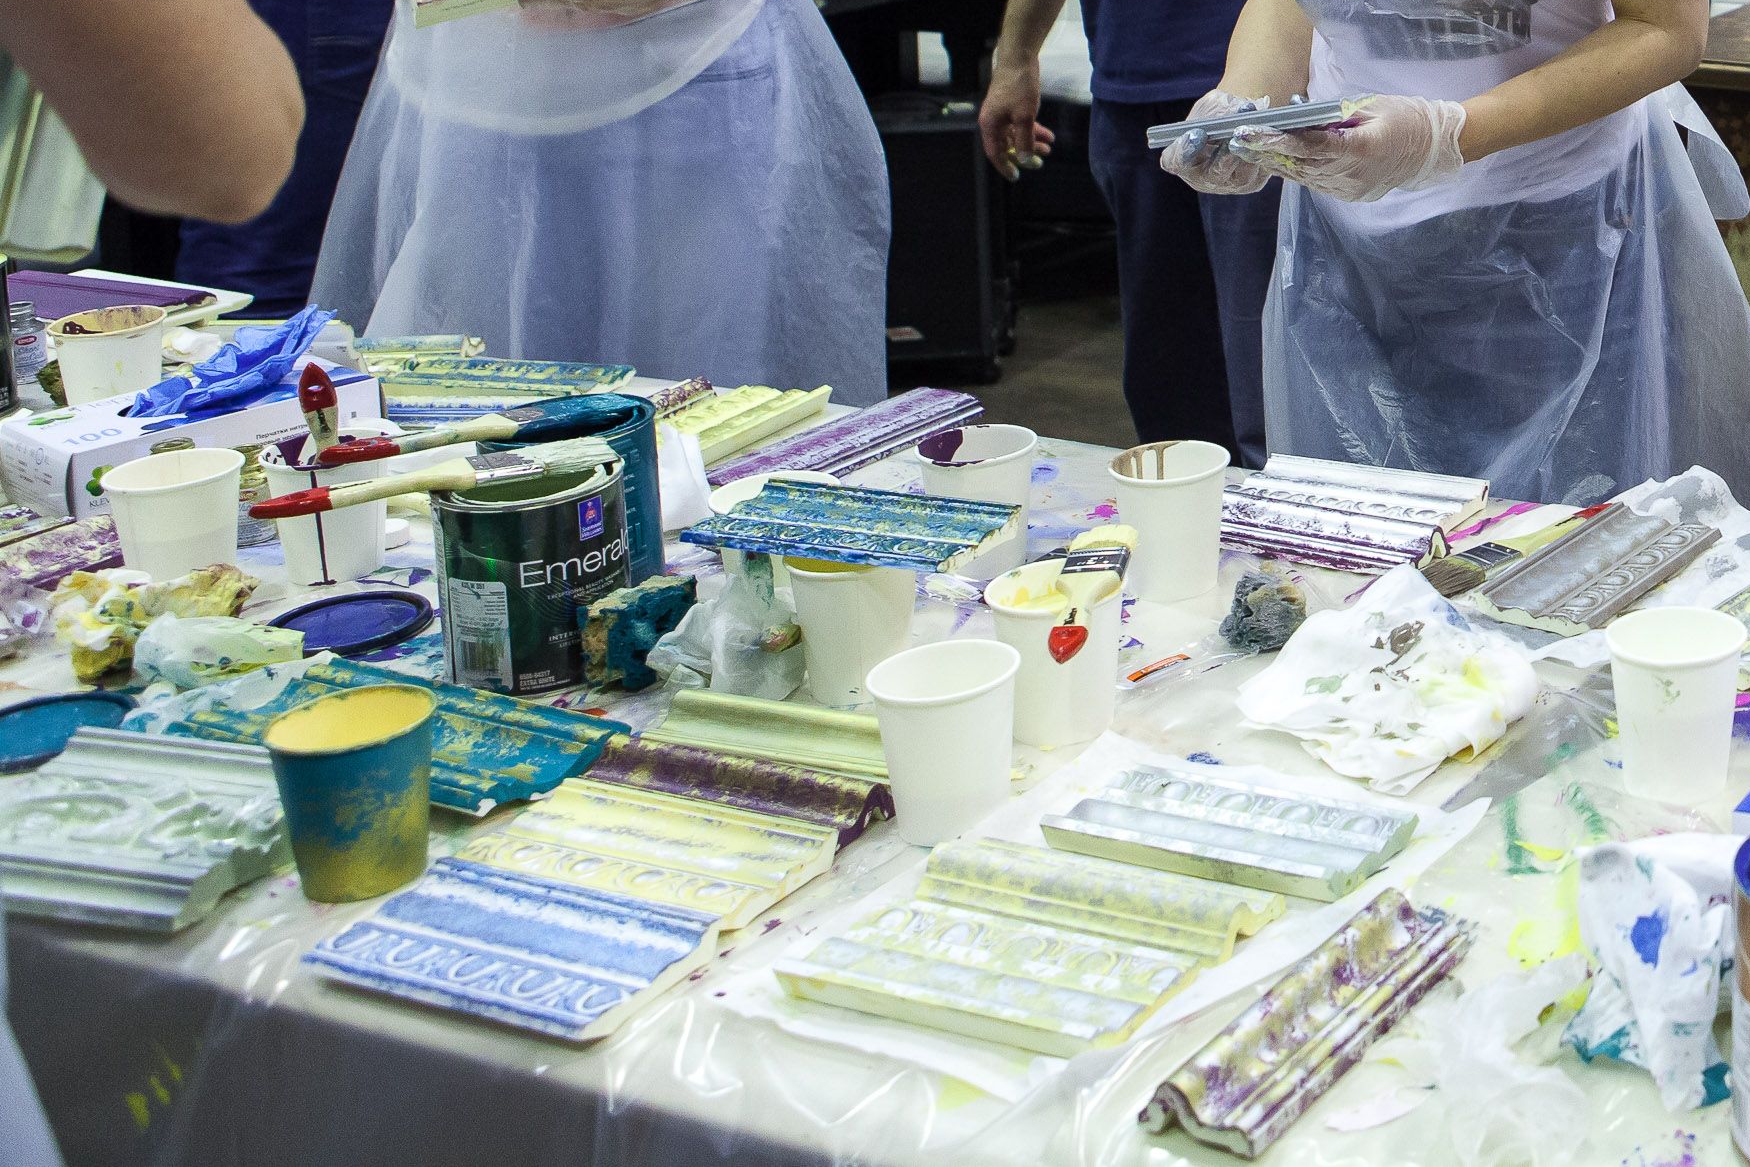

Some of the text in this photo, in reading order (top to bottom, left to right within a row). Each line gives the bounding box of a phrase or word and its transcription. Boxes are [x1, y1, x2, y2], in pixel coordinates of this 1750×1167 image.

[63, 428, 122, 445] 100
[256, 427, 288, 440] Перчатки
[89, 497, 111, 508] KLEV
[549, 631, 580, 642] INTER
[538, 676, 555, 684] WHITE
